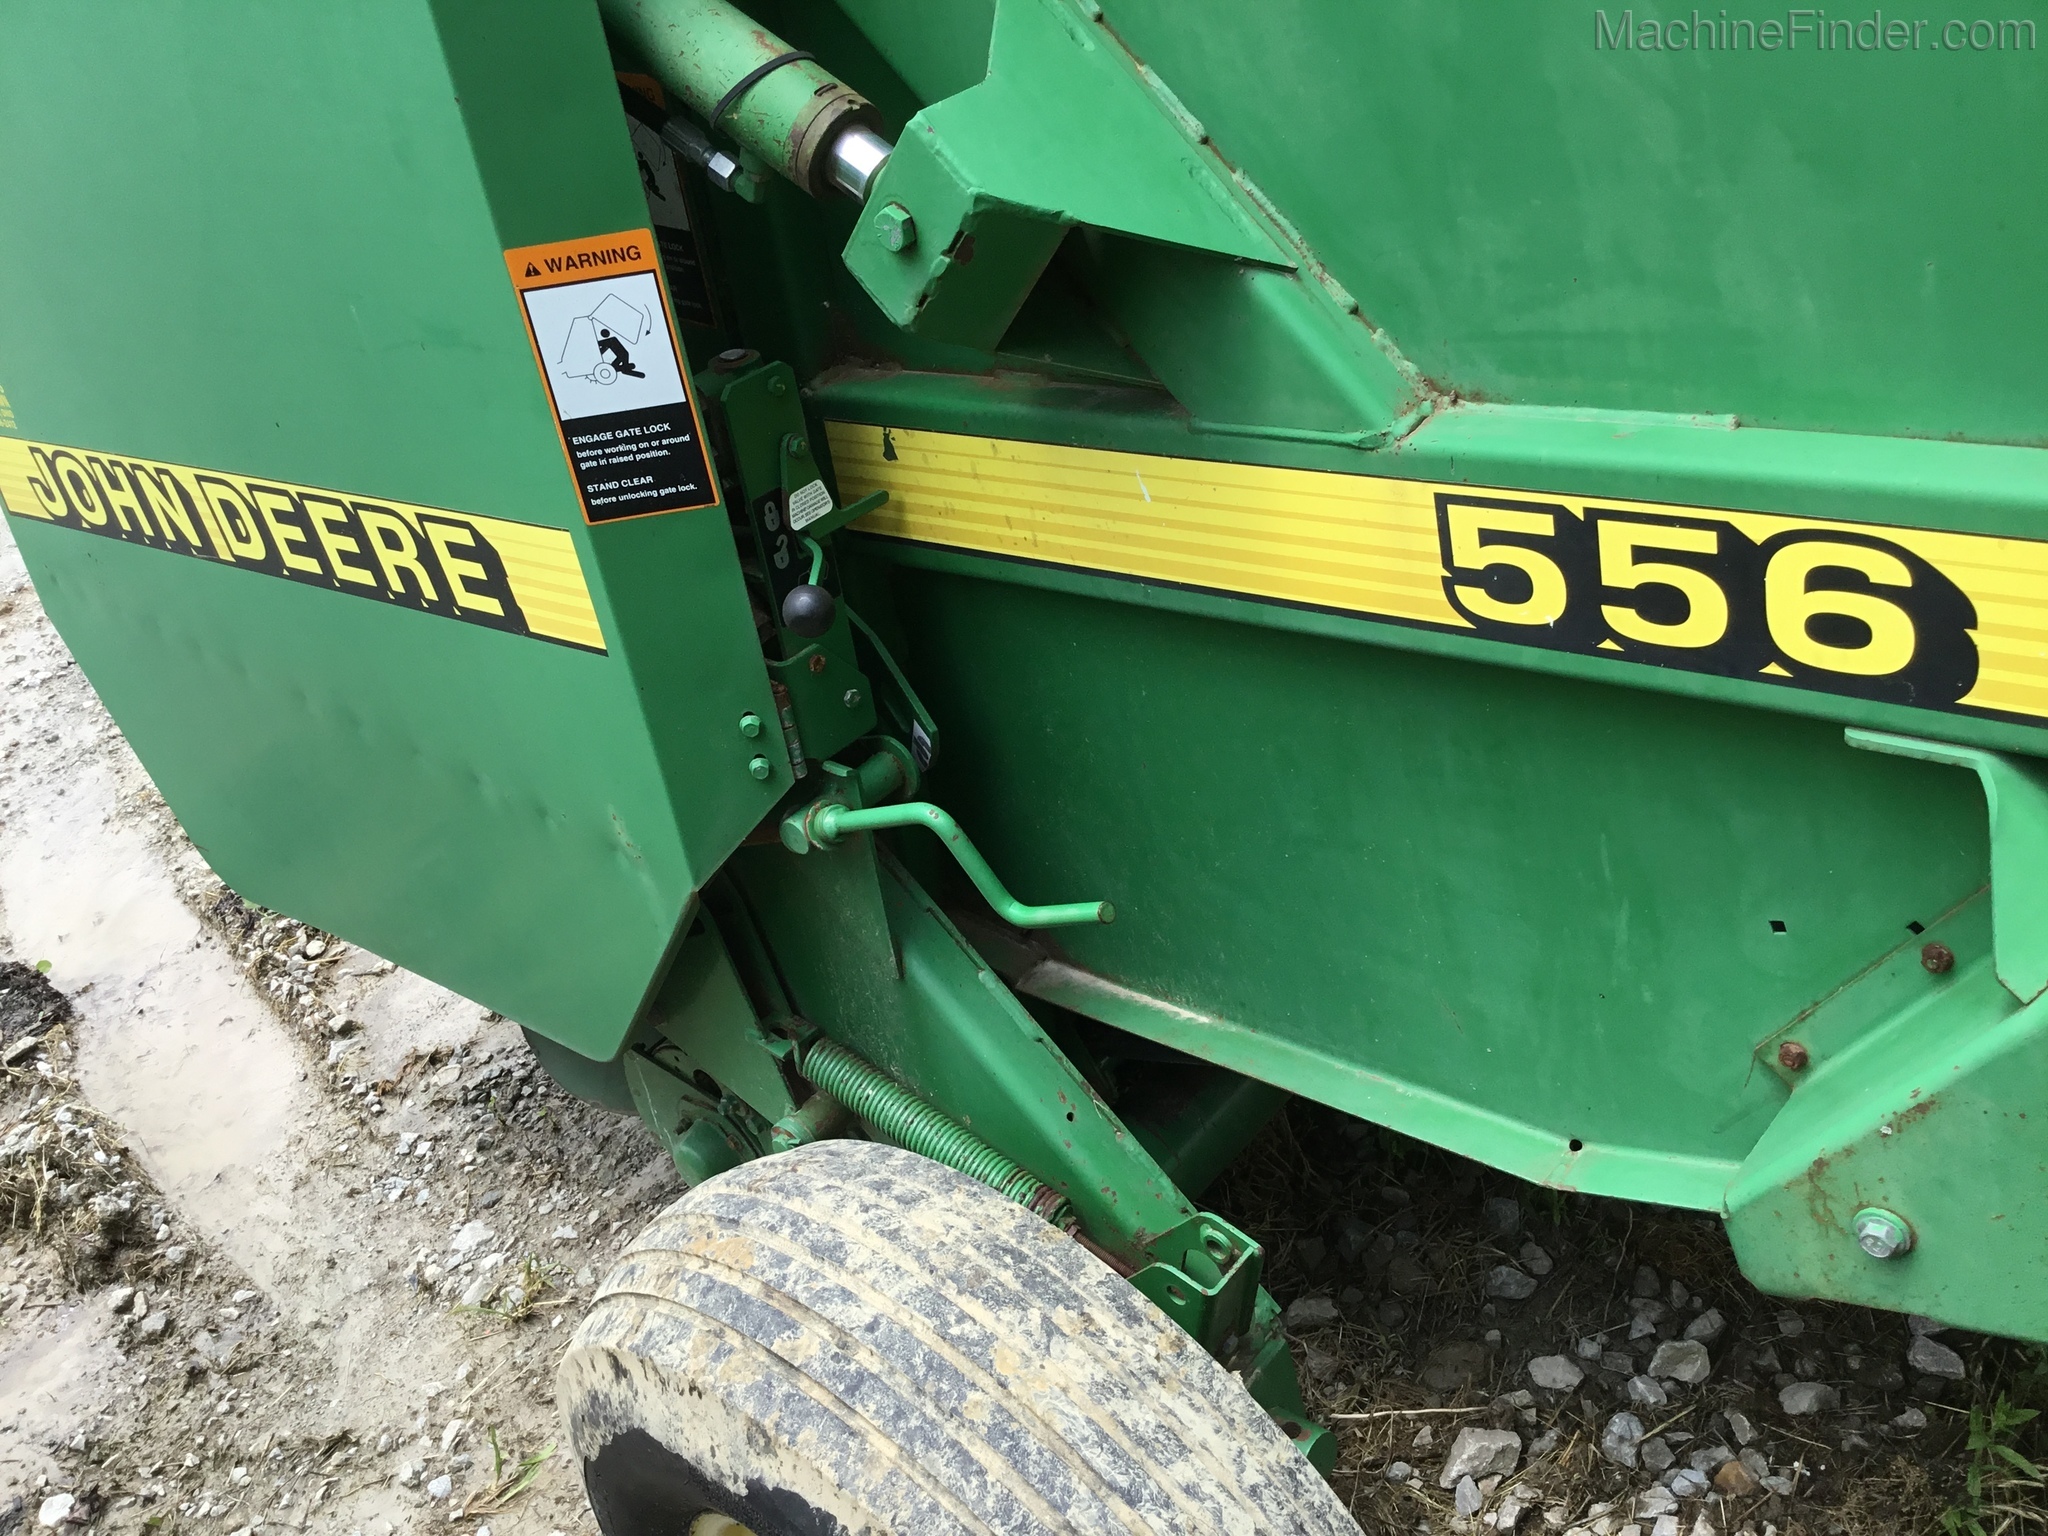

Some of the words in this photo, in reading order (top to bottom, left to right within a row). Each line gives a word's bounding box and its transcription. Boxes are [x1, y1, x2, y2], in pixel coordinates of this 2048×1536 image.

[544, 245, 642, 273] WARNING
[572, 432, 614, 445] ENGAGE
[615, 427, 642, 439] GATE
[643, 422, 671, 434] LOCK
[576, 447, 603, 458] before
[604, 443, 637, 455] working
[661, 434, 690, 445] around
[580, 458, 598, 470] gate
[599, 457, 608, 466] in
[608, 453, 634, 464] raised
[635, 448, 671, 462] position.
[587, 480, 620, 493] STAND
[621, 475, 654, 488] CLEAR
[590, 494, 617, 506] before
[618, 488, 658, 502] unlocking
[659, 485, 677, 497] gate
[678, 482, 698, 493] lock.
[29, 446, 202, 549] JOHN
[200, 476, 505, 617] DEERE
[1445, 502, 1917, 677] 556
